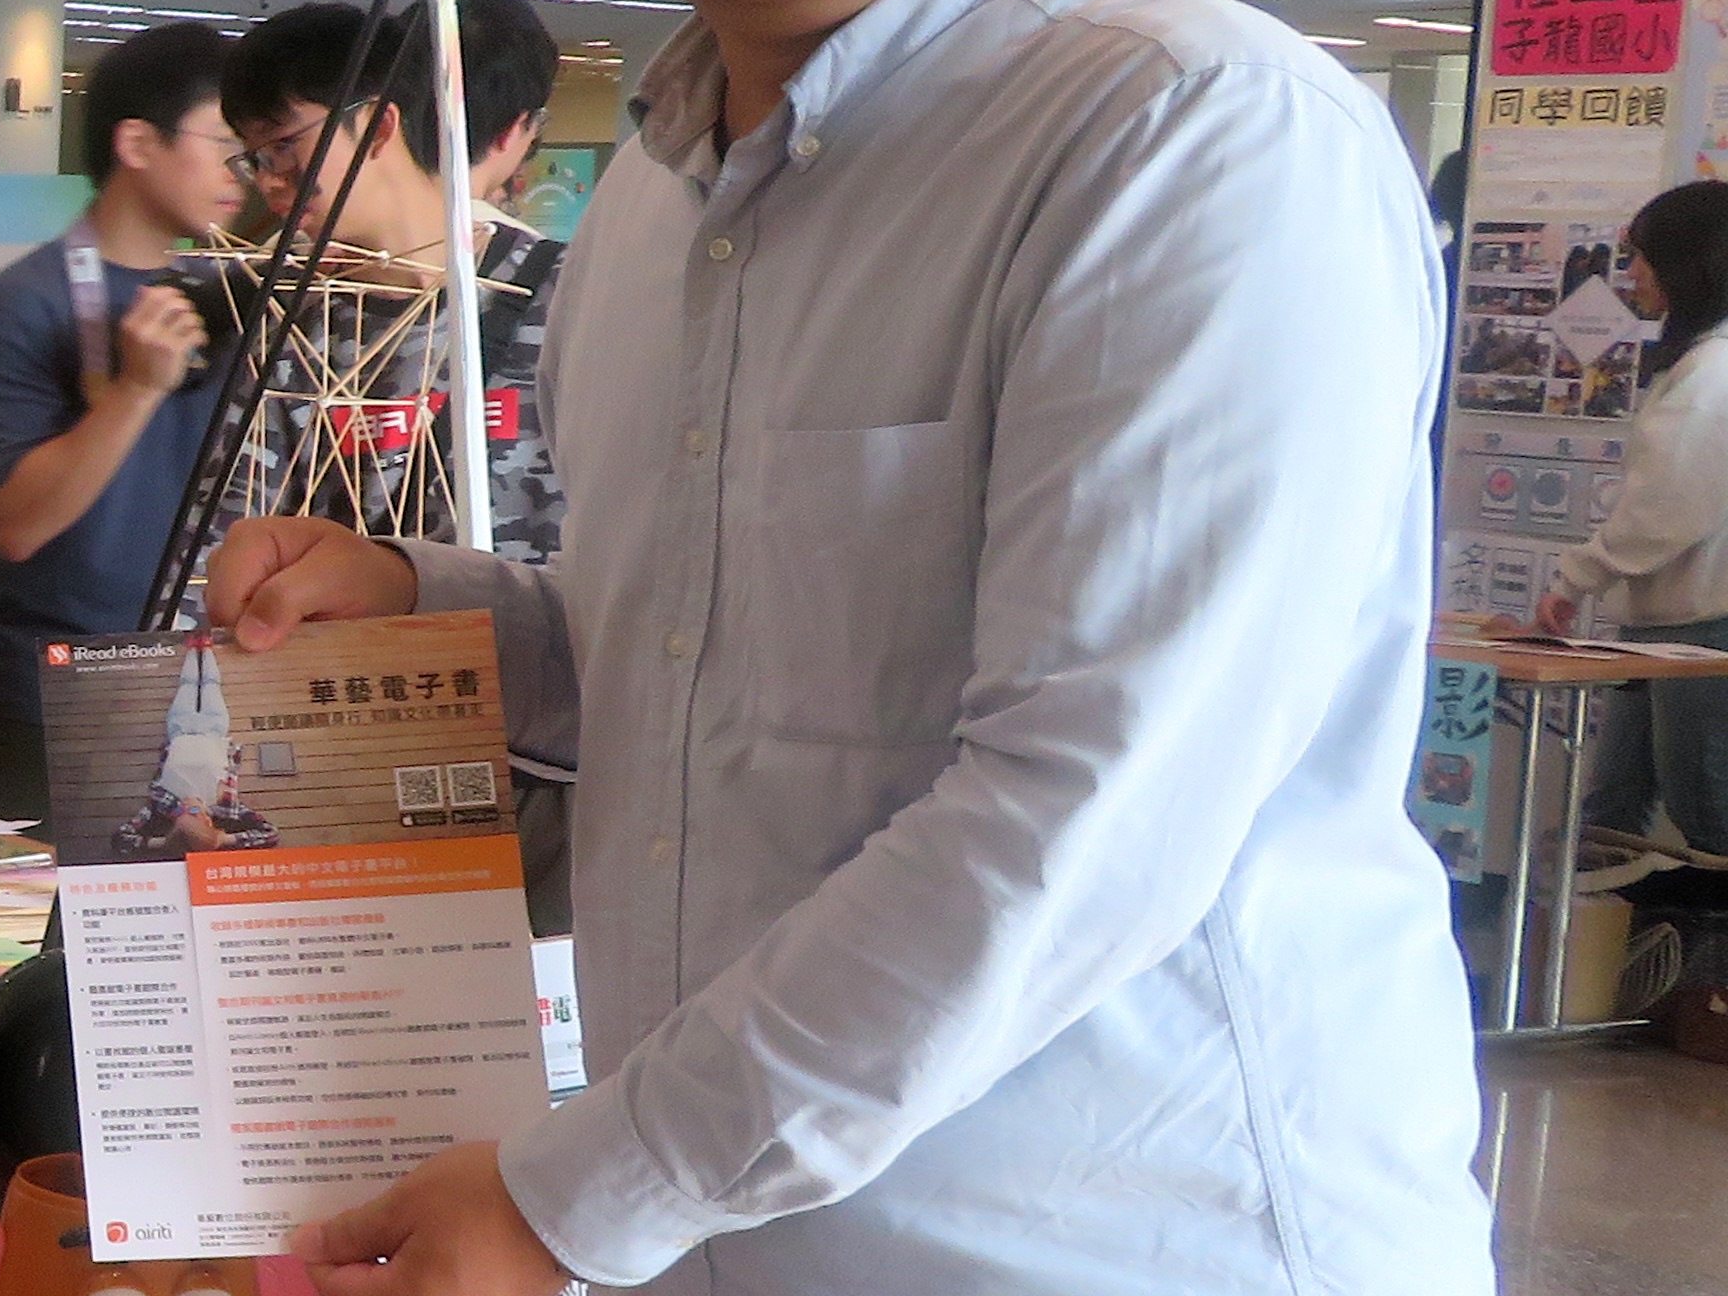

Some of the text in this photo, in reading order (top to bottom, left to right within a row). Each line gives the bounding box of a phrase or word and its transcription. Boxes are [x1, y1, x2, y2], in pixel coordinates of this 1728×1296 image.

[1501, 13, 1673, 64] 子龍國小
[1489, 86, 1667, 128] 同學回饋
[72, 643, 176, 662] iRead eBooks
[309, 669, 481, 705] 華藝電子書
[135, 1221, 173, 1241] airiti
